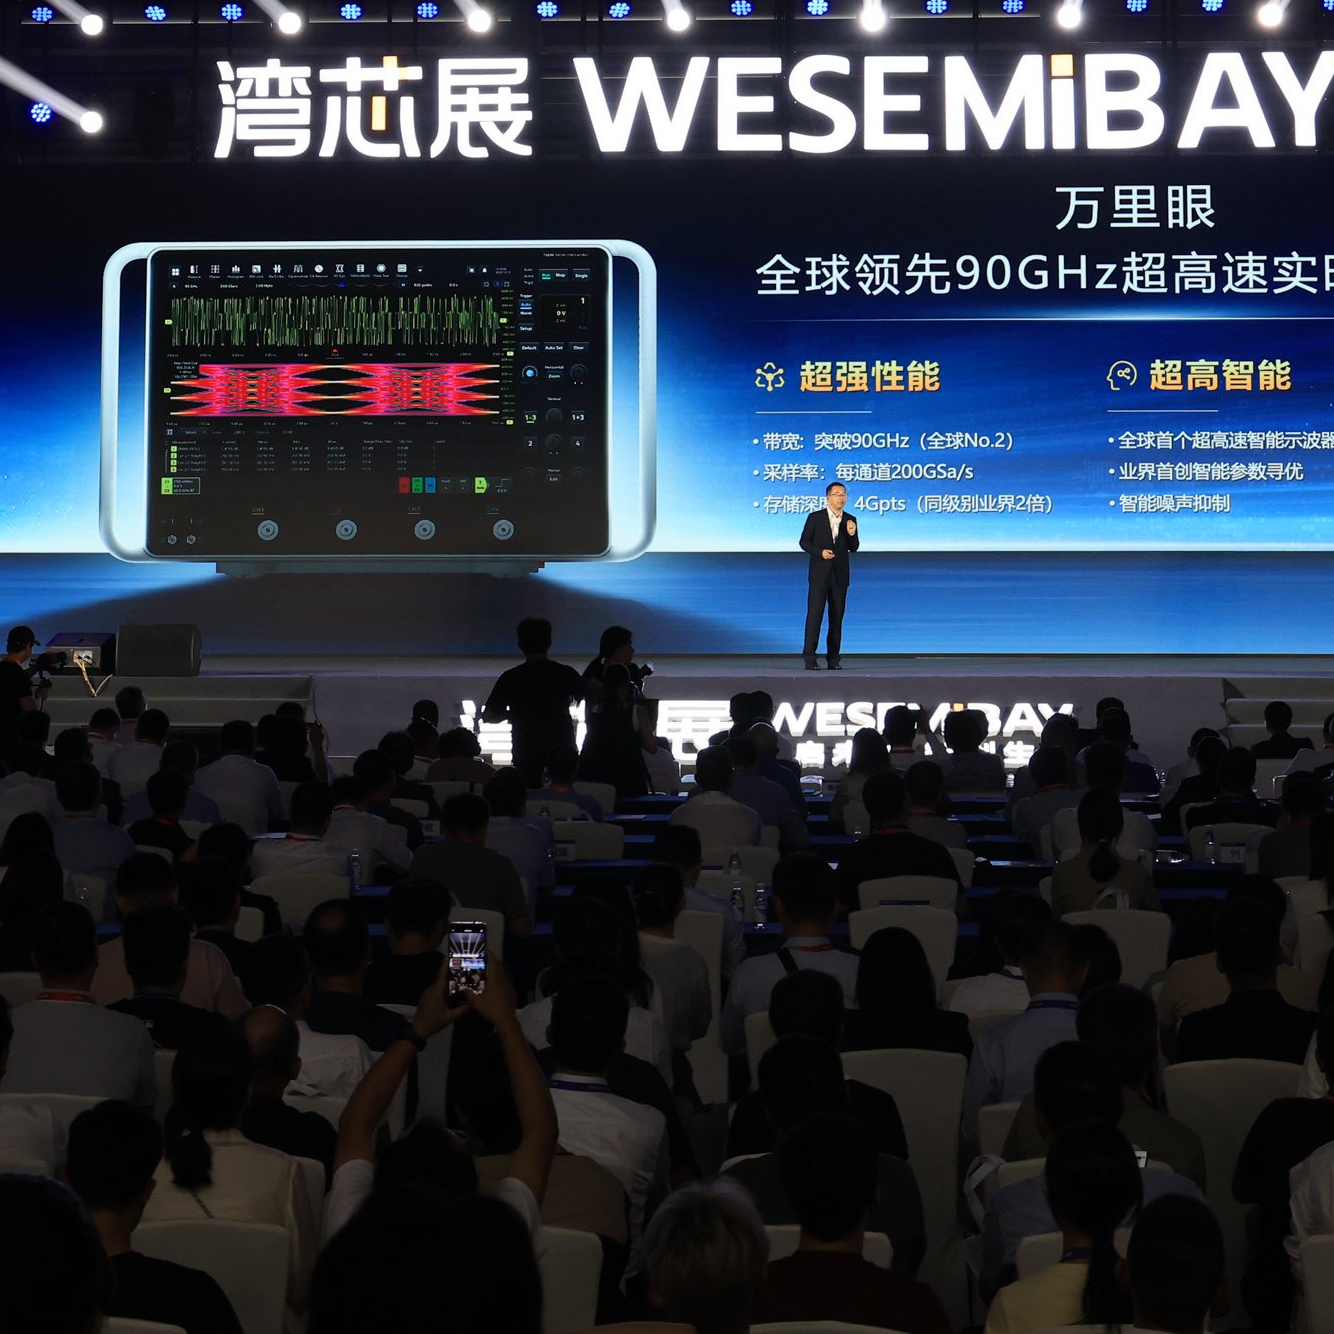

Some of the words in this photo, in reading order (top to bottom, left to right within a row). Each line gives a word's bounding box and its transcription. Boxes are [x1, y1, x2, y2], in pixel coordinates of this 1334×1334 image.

[213, 54, 534, 159] 湾芯展
[1055, 184, 1216, 231] 万里眼
[799, 360, 941, 393] 超强性能
[1149, 358, 1293, 392] 超高智能
[1119, 462, 1304, 482] 业界首创智能参数寻优
[1119, 494, 1230, 514] 智能噪声抑制
